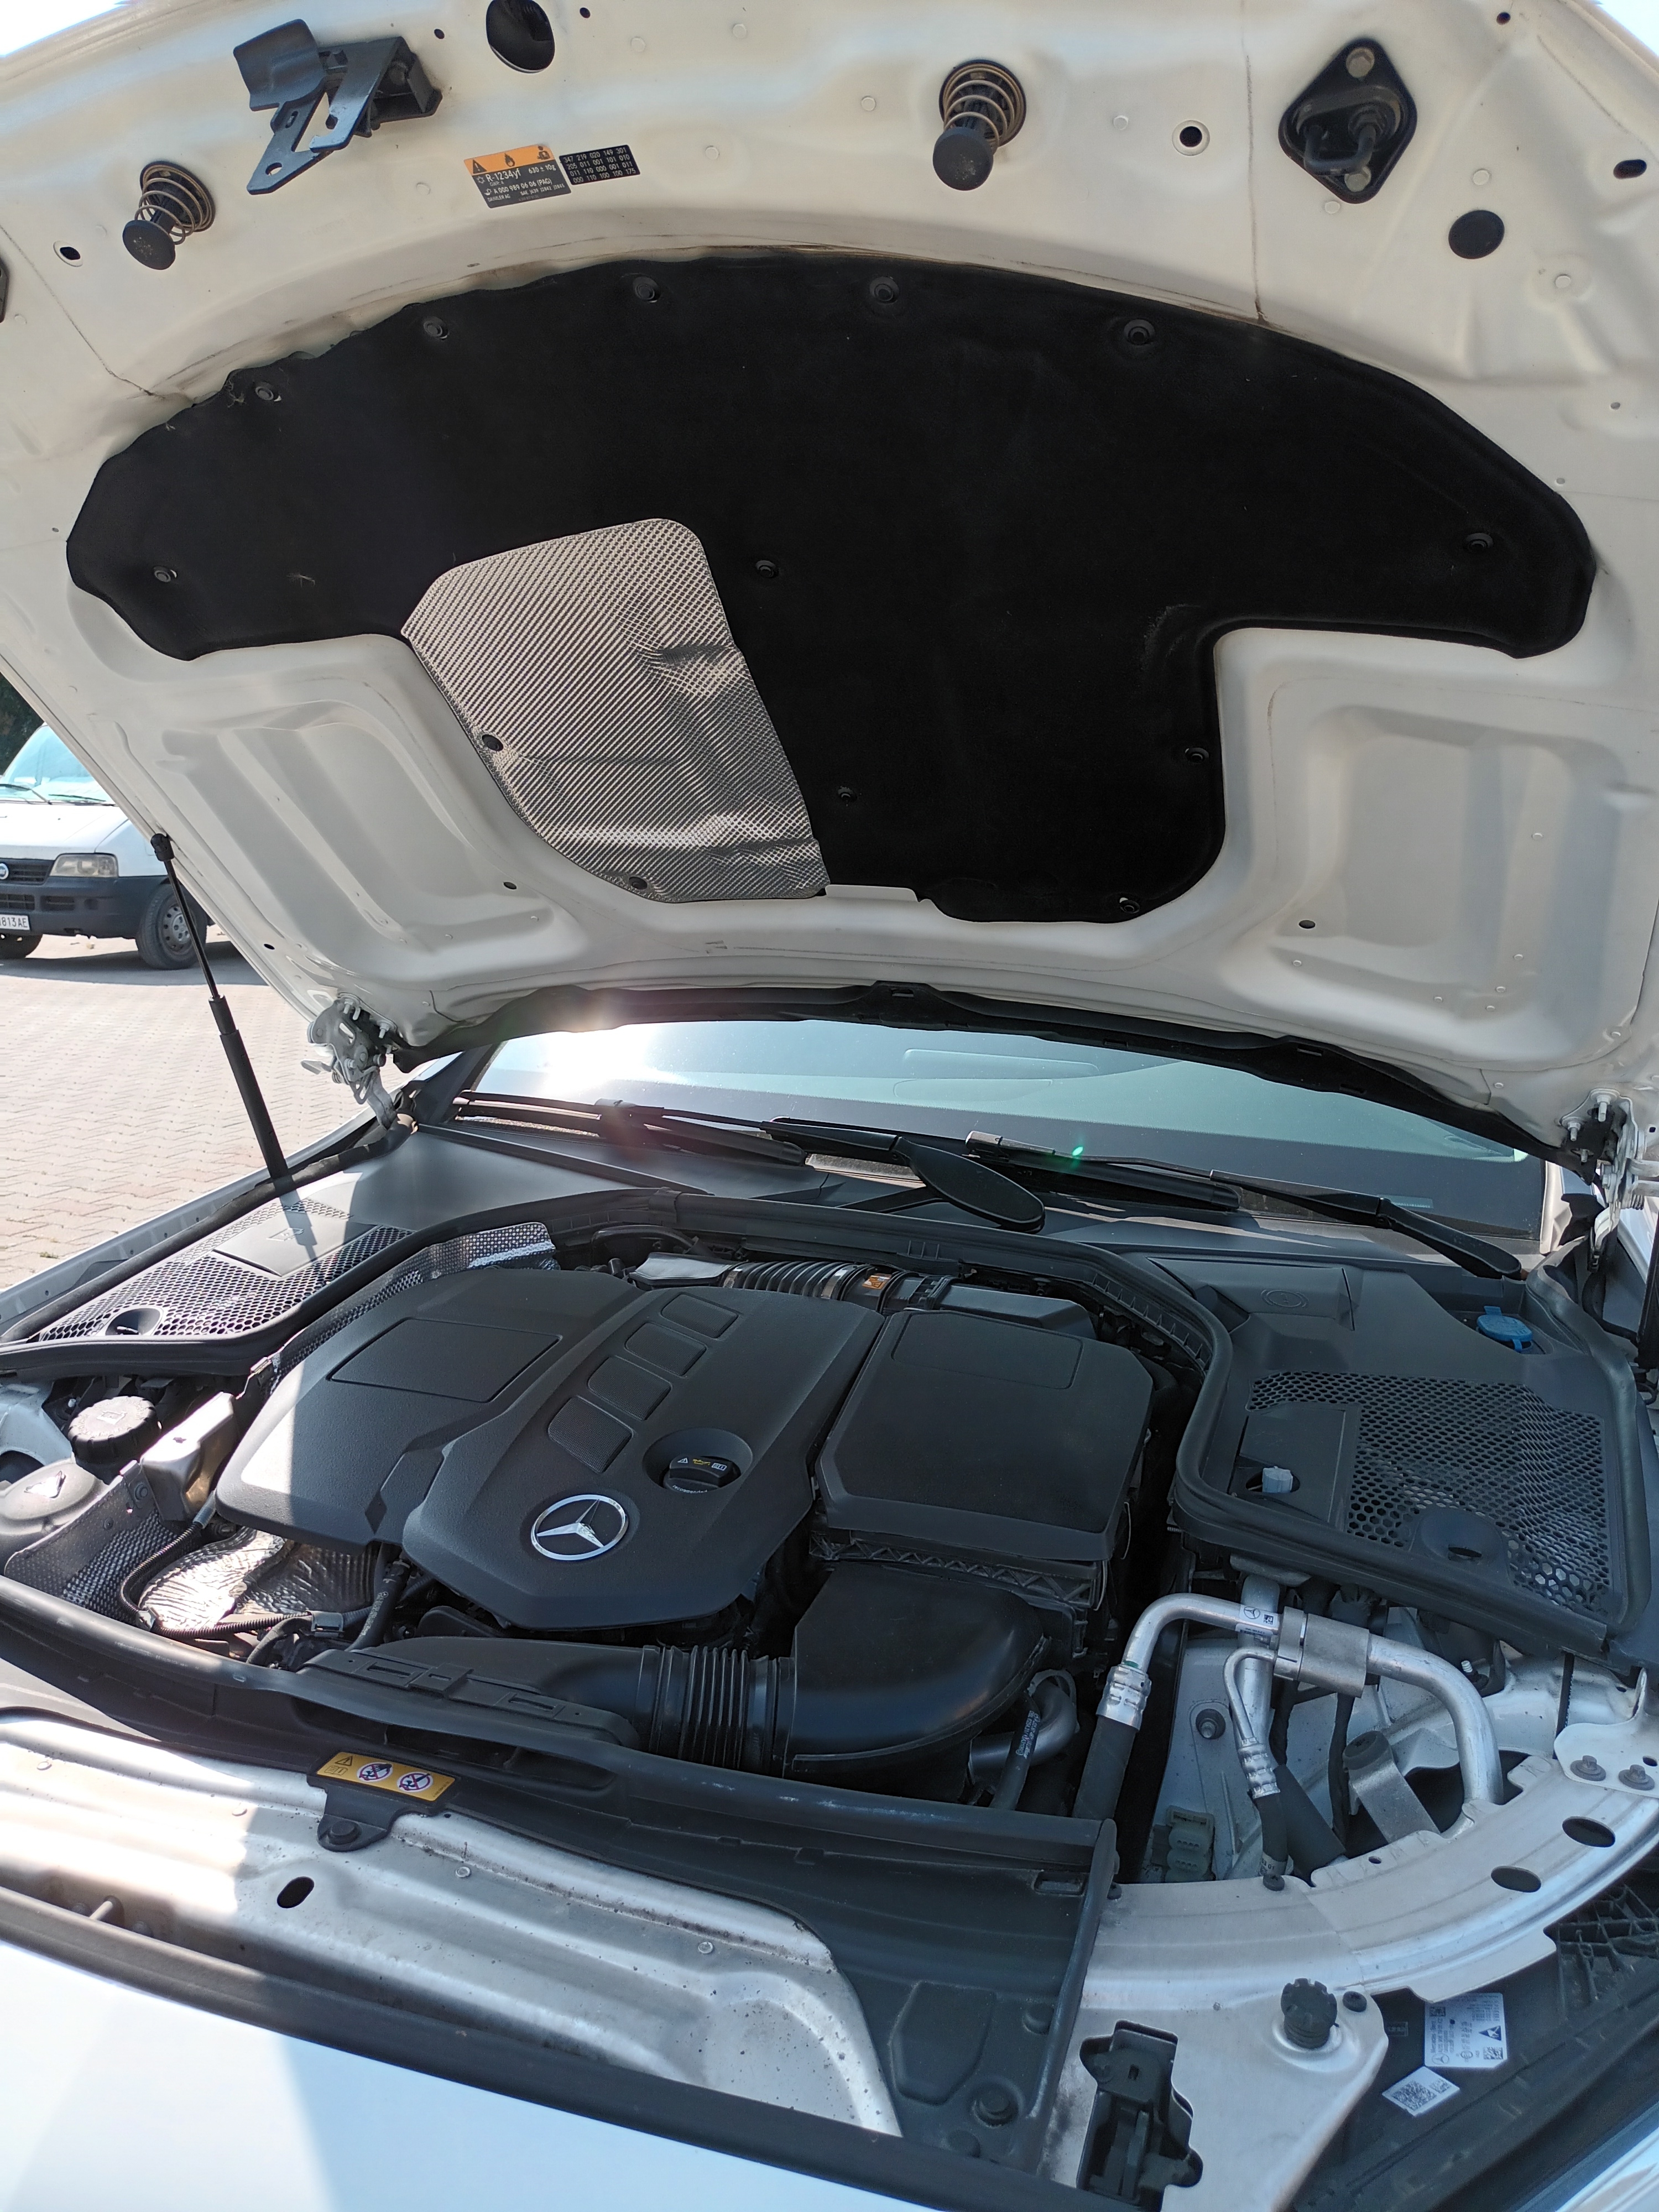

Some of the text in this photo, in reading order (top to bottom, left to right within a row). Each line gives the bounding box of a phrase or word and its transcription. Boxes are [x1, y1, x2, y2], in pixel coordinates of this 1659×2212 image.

[486, 168, 521, 182] R-1234yf
[536, 178, 552, 187] (PAG)
[0, 916, 28, 928] 813AE
